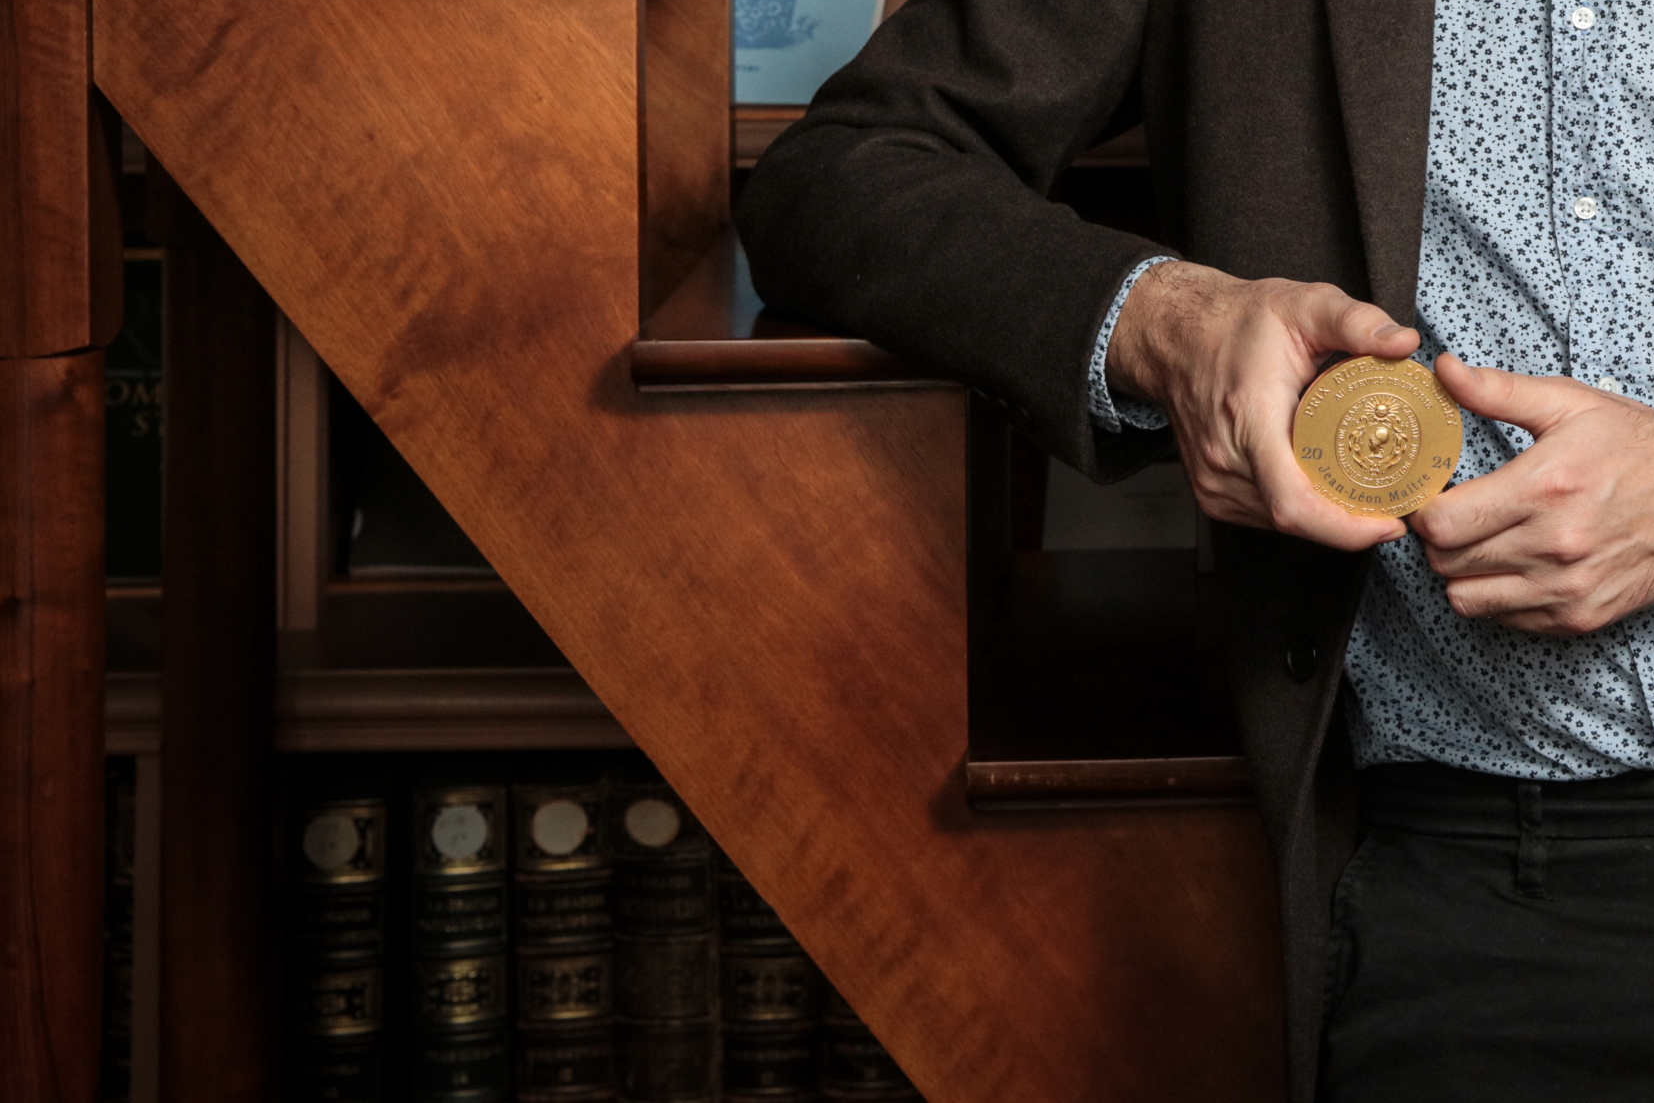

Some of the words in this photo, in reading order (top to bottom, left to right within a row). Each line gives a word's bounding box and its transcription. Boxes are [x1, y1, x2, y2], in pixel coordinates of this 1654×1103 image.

[1304, 387, 1331, 418] PRIX
[1332, 361, 1396, 385] RICHARD
[1334, 389, 1346, 402] AU
[1347, 376, 1385, 392] SERVICE
[1387, 376, 1399, 386] DE
[1301, 446, 1323, 461] 20
[1431, 455, 1452, 469] 24
[1318, 465, 1383, 504] Jean-Léon
[1388, 471, 1431, 503] Maître
[1361, 507, 1376, 517] ET
